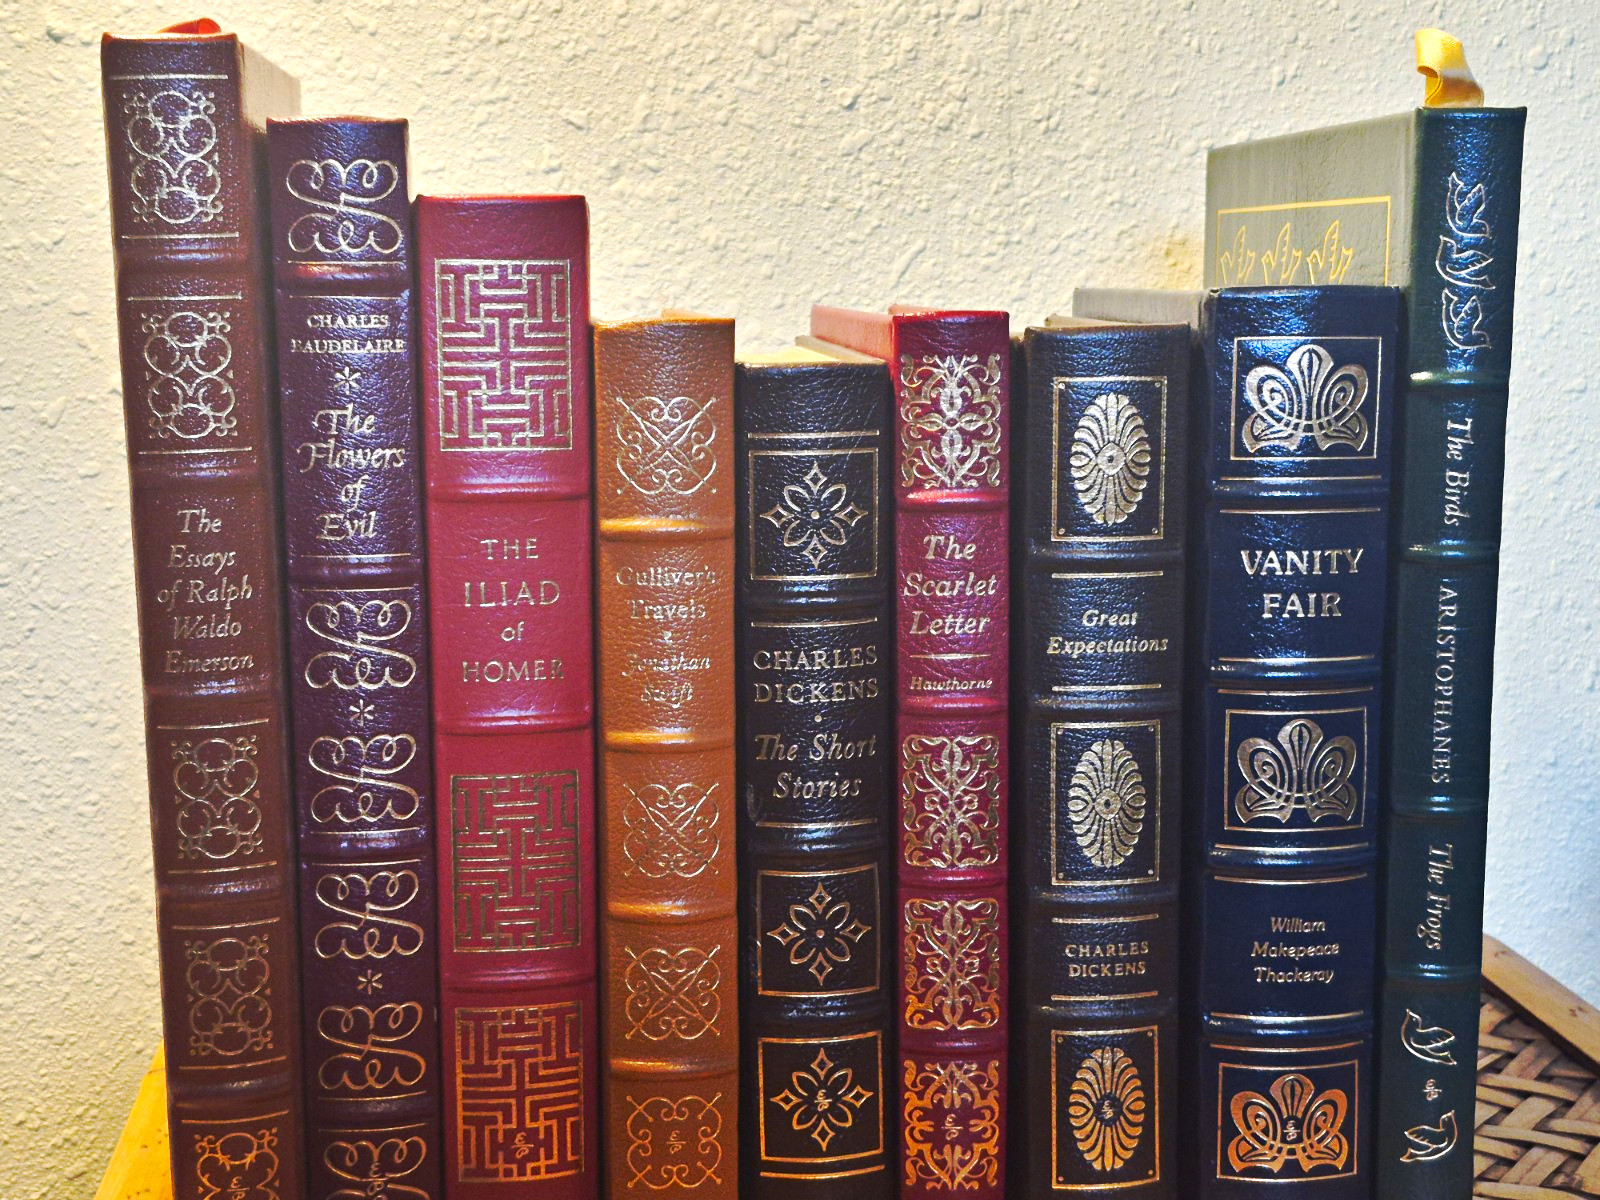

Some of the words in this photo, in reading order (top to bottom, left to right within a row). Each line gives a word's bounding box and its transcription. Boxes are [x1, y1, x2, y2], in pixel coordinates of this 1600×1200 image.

[306, 314, 390, 329] CHARLES
[290, 339, 406, 354] BAUDELAIRE
[312, 403, 377, 435] The
[1446, 418, 1474, 460] The
[296, 438, 406, 473] Flowers
[340, 474, 370, 513] of
[1444, 468, 1470, 526] Birds
[177, 508, 222, 533] The
[315, 510, 377, 541] Evil
[167, 544, 236, 575] Essays
[480, 539, 539, 560] THE
[923, 535, 977, 560] The
[1240, 548, 1364, 575] VANITY
[616, 565, 717, 586] Gulliver's
[903, 572, 997, 597] Scarlet
[157, 579, 183, 612] of
[187, 574, 253, 610] Ralph
[464, 580, 561, 607] ILIAD
[1262, 592, 1342, 618] FAIR
[624, 599, 707, 620] Travels
[1082, 609, 1138, 627] Great
[173, 613, 242, 640] Waldo
[501, 621, 525, 641] of
[909, 610, 991, 635] Letter
[753, 645, 878, 670] CHARLES
[1046, 635, 1169, 659] Expectations
[164, 650, 254, 673] Emerson
[462, 659, 565, 682] HOMER
[754, 678, 879, 704] DICKENS
[909, 676, 993, 690] Hawthorne
[1432, 585, 1458, 783] ARISTOPHANES
[755, 733, 799, 761] The
[809, 733, 877, 761] Short
[773, 771, 862, 799] Stories
[1427, 843, 1454, 885] The
[1270, 916, 1326, 933] William
[1417, 891, 1450, 950] Frogs
[1065, 941, 1149, 957] CHARLES
[1250, 941, 1340, 960] Makepeace
[1068, 961, 1146, 977] DICKENS
[1253, 966, 1335, 984] Thackeray
